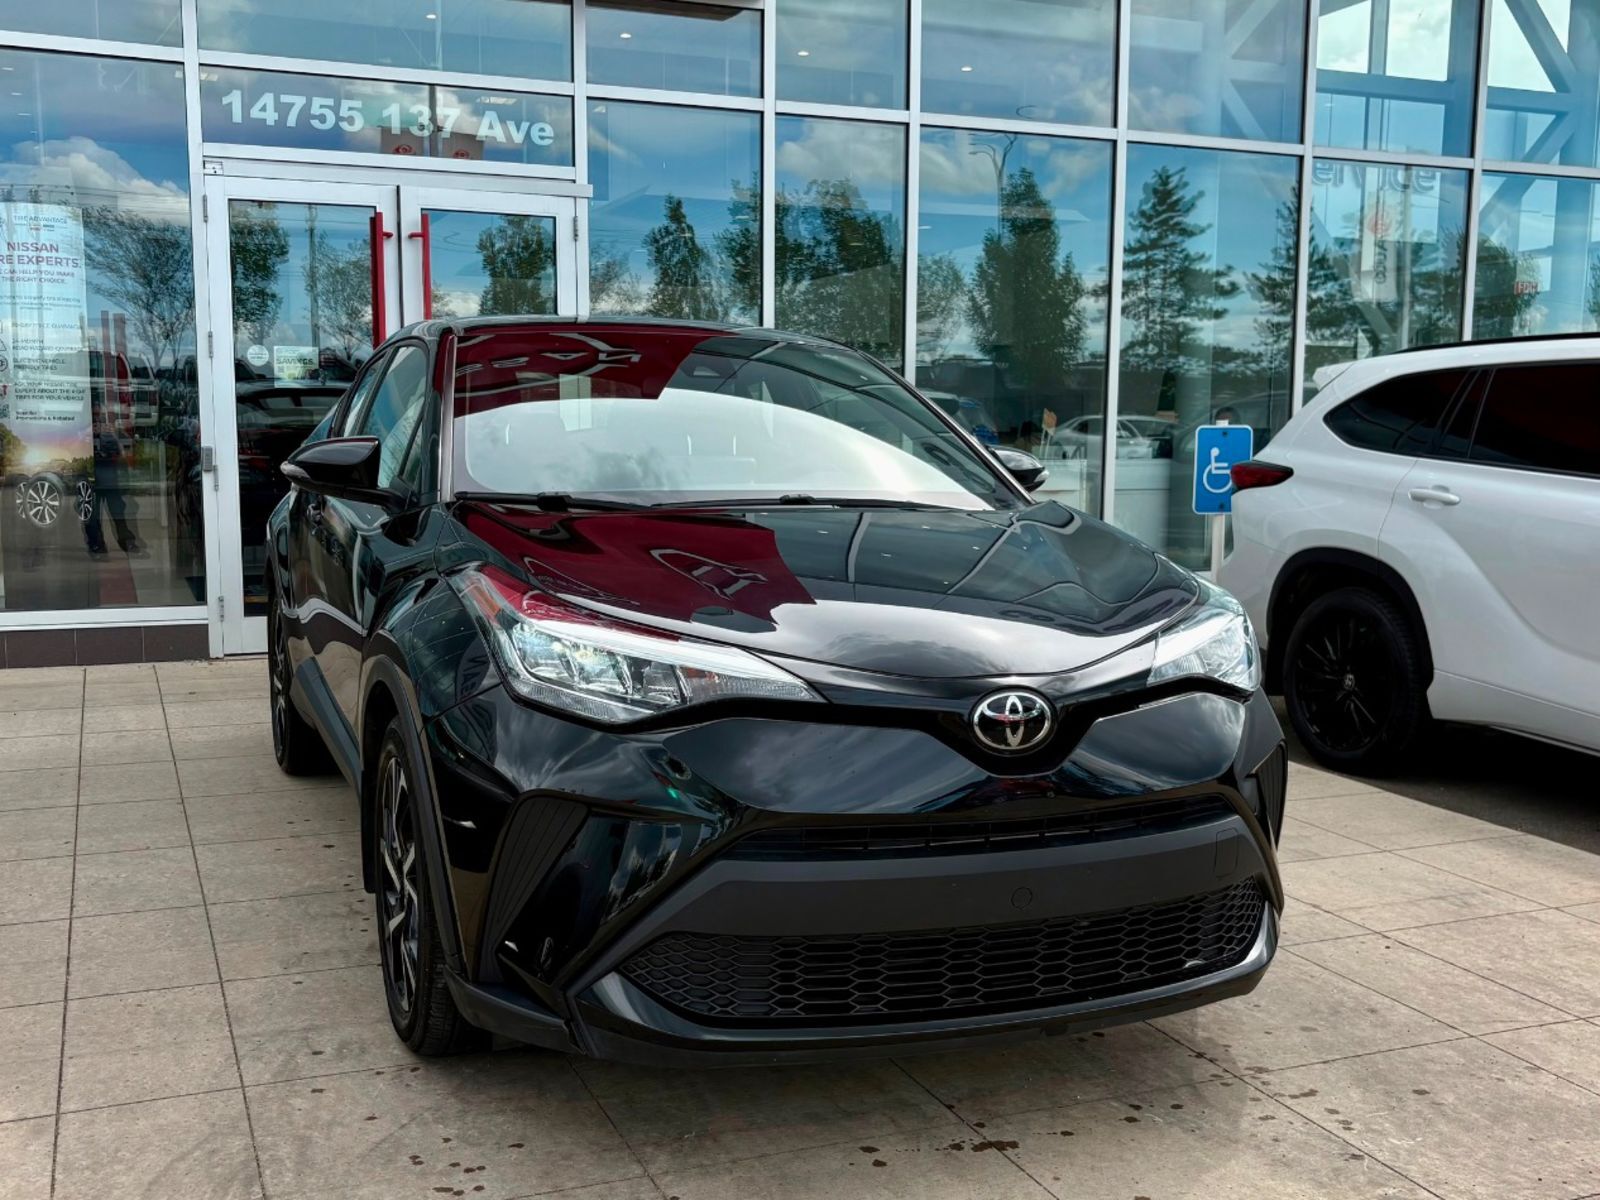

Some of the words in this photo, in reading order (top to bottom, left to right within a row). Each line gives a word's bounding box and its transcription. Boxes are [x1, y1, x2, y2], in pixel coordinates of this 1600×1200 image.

[221, 89, 365, 133] 14755
[382, 102, 461, 139] 137
[476, 110, 555, 147] Ave
[7, 241, 60, 254] NISSAN
